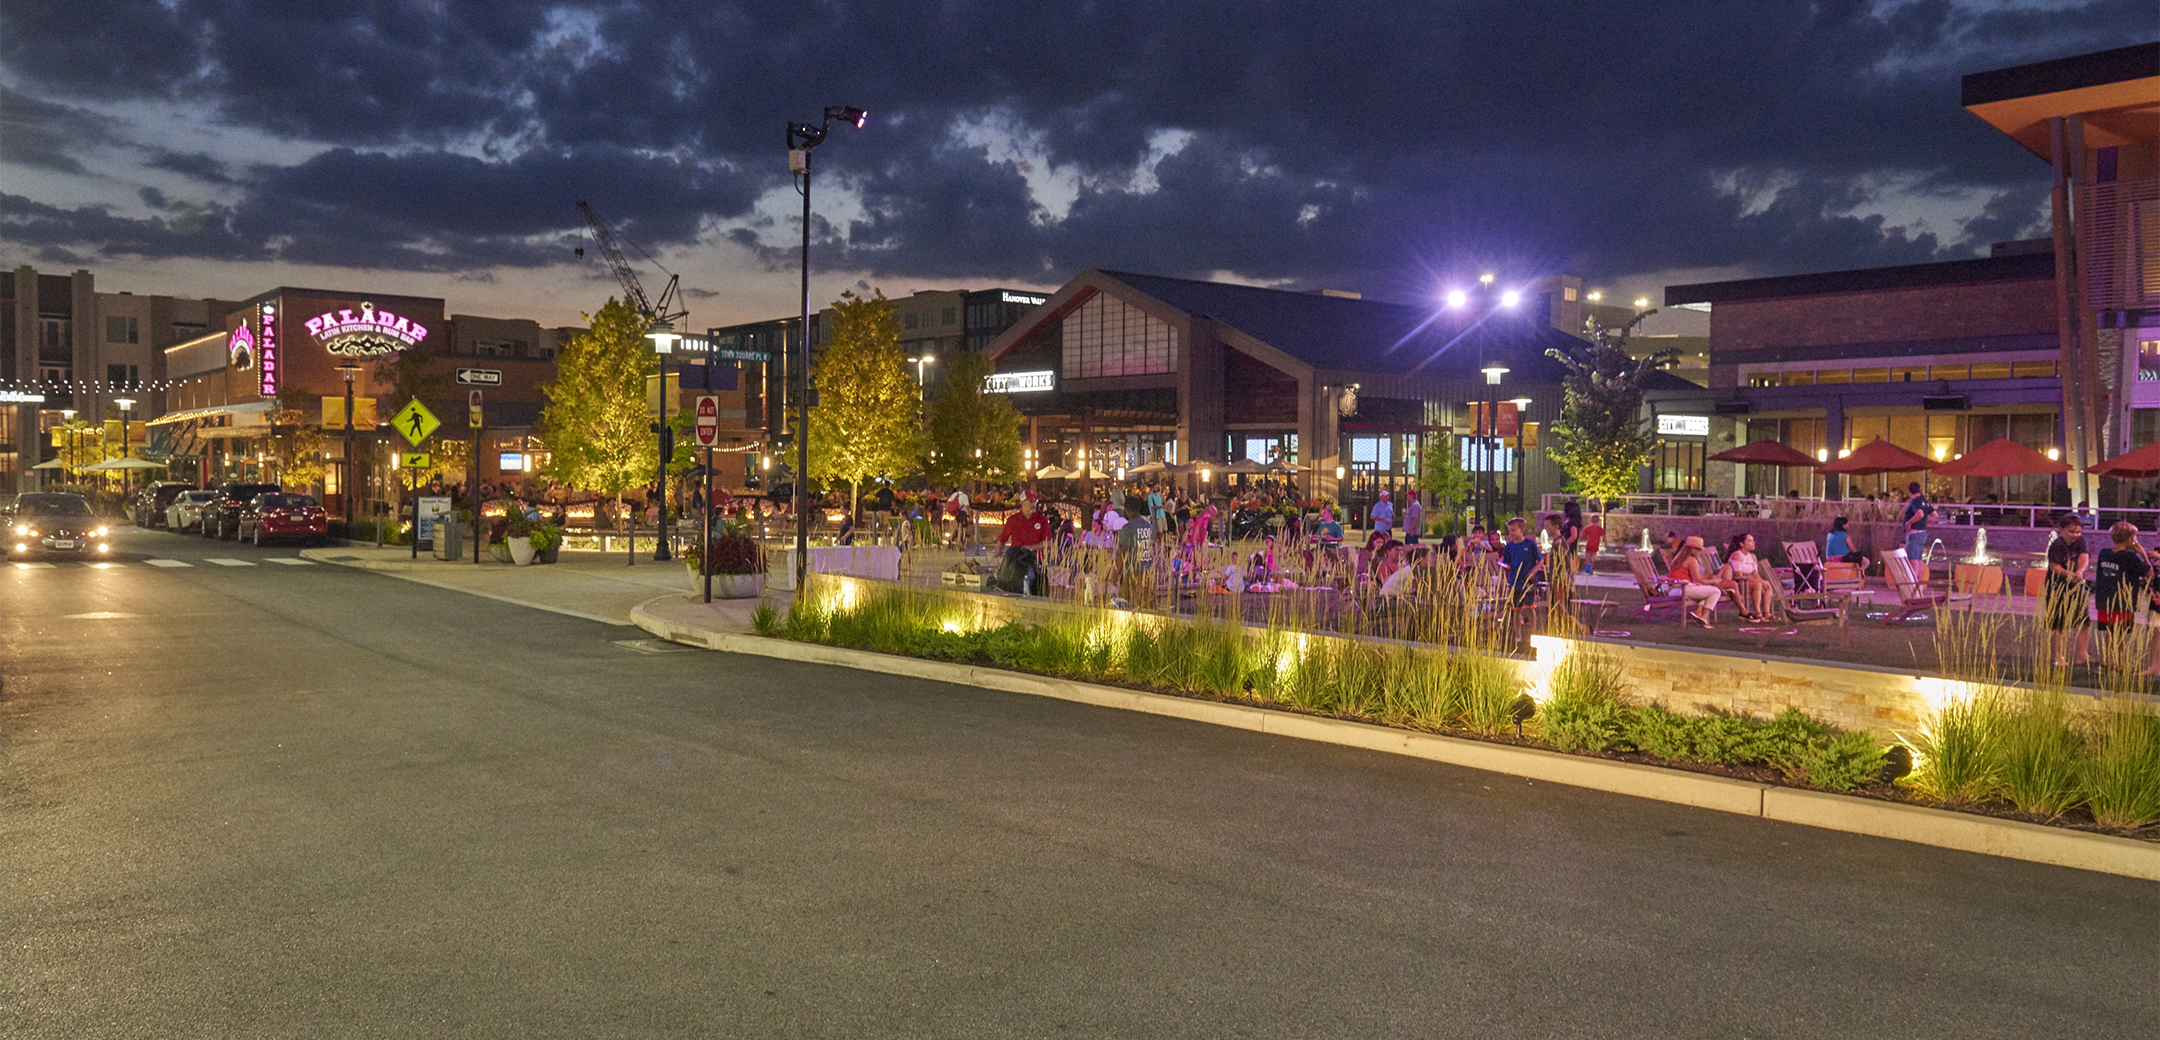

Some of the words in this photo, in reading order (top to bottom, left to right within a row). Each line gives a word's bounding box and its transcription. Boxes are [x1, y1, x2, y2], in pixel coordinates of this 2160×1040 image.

[1002, 291, 1030, 304] HANOVER
[304, 309, 428, 342] PALADAR
[319, 327, 341, 341] LATIN
[341, 323, 374, 333] KITCHEN
[375, 325, 382, 333] &
[382, 326, 400, 338] RUM
[400, 334, 416, 346] BAR
[262, 314, 276, 395] PALADAR
[721, 349, 735, 358] TOWN
[736, 351, 755, 360] SQUARE
[986, 377, 1007, 389] CITY
[1019, 375, 1051, 388] WORKS
[700, 406, 706, 415] DO
[706, 406, 715, 415] NOT
[1659, 418, 1677, 431] CITY
[700, 428, 713, 436] ENTER
